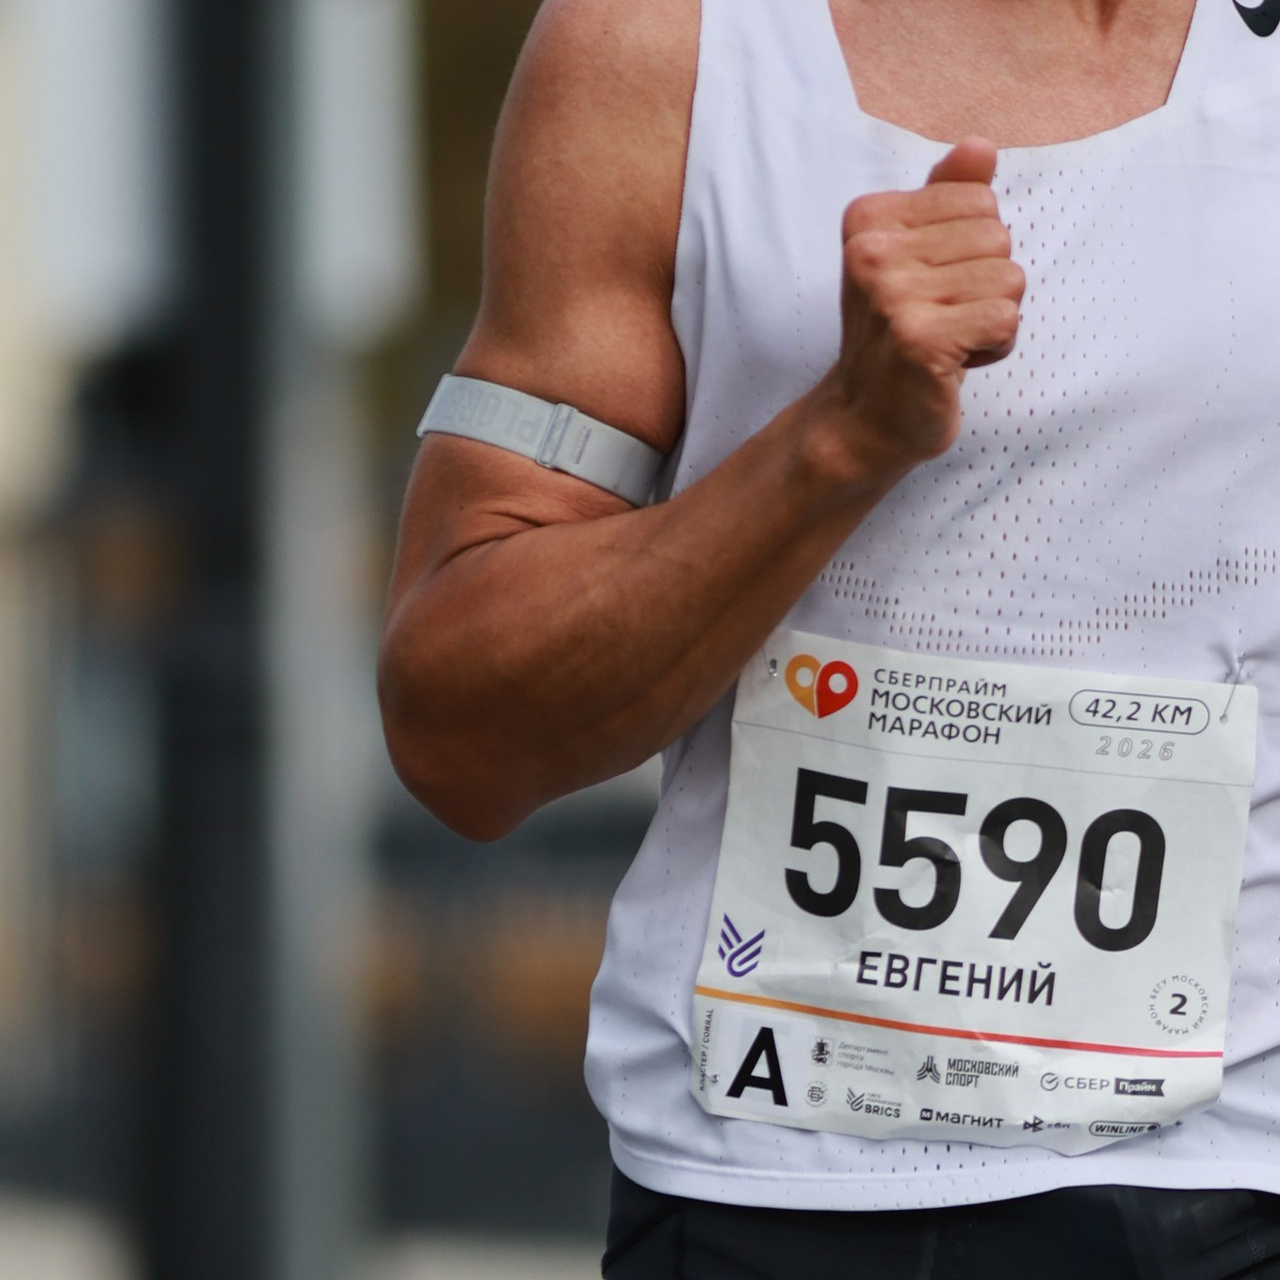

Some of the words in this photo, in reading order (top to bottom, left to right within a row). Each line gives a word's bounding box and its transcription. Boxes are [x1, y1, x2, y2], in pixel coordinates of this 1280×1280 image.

[874, 668, 1007, 698] СБЕРПРАЙМ
[870, 688, 1053, 726] МОСКОВСКИЙ
[1084, 698, 1142, 723] 42,2
[868, 712, 1001, 745] МАРАФОН
[1095, 735, 1175, 761] 2026
[784, 767, 1166, 952] 5590
[856, 951, 1056, 1006] ЕВГЕНИЙ
[1169, 992, 1188, 1016] 2
[702, 1008, 714, 1043] CORRAL
[945, 1072, 979, 1088] СПОРТ
[946, 1058, 1019, 1078] МОСКОВСКИЙ
[1064, 1077, 1110, 1090] СБЕР
[1119, 1081, 1157, 1093] Прайм
[865, 1103, 901, 1119] BRICS
[1094, 1123, 1146, 1134] WINLINE
